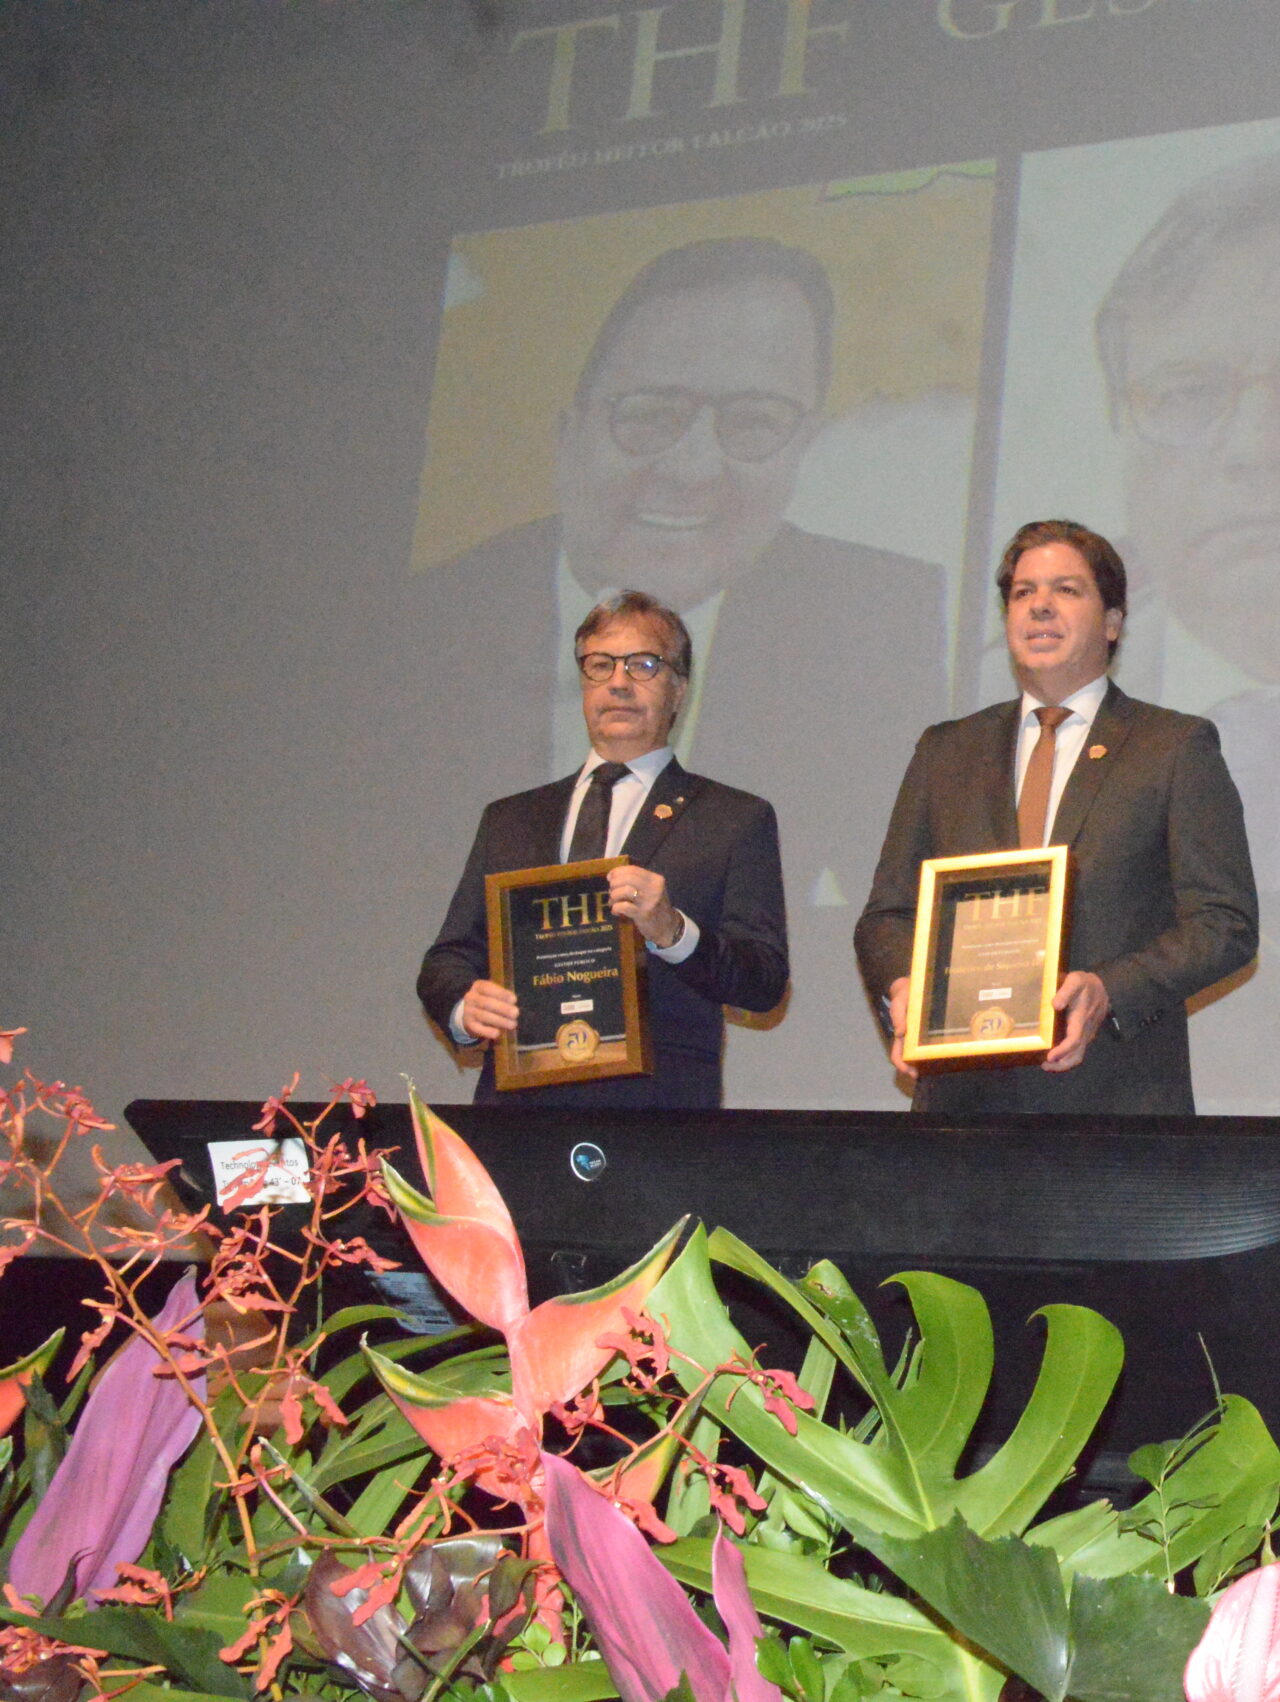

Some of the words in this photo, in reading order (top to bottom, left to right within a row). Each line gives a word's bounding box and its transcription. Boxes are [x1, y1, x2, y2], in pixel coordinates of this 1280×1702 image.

[509, 0, 849, 138] THF
[964, 886, 1046, 921] THF
[532, 972, 565, 987] Fábio
[566, 966, 620, 984] Nogueira
